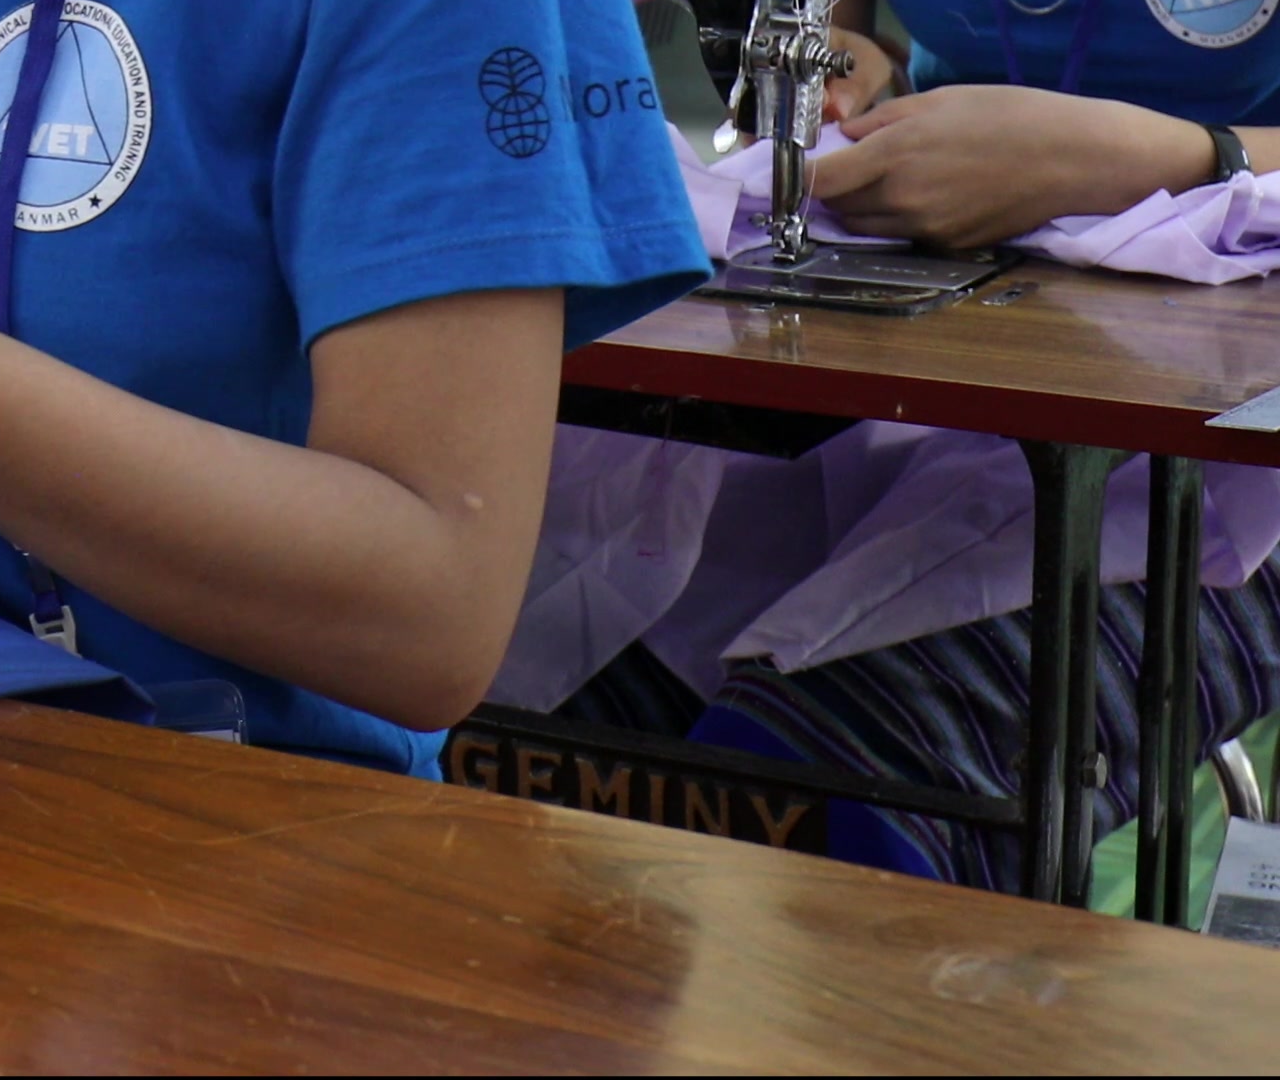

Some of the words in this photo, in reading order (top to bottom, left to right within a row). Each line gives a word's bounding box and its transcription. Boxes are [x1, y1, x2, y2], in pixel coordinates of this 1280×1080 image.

[63, 1, 115, 31] OCATIONAL
[111, 24, 145, 87] EDUCATION
[133, 89, 147, 119] AND
[113, 123, 147, 183] TRAINING
[16, 207, 81, 225] ANMAR
[448, 733, 813, 849] GEMINY
